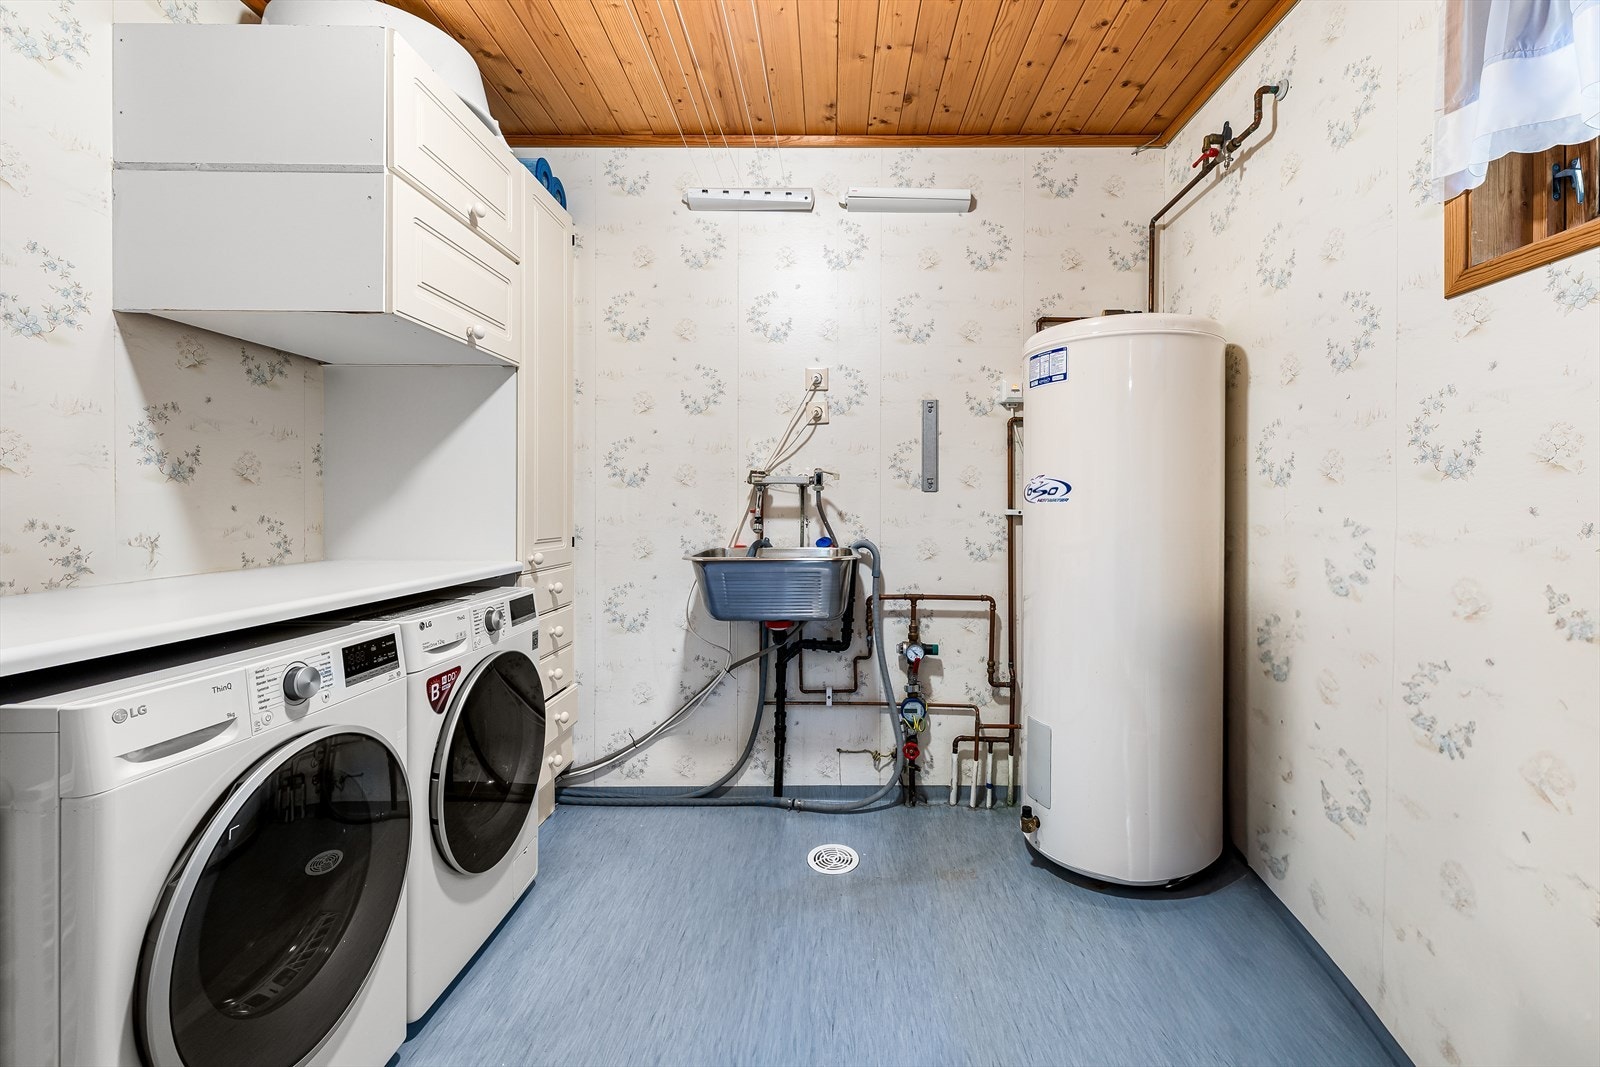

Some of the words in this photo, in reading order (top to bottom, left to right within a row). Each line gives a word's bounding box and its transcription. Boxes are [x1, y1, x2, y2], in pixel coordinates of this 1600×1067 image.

[211, 682, 232, 694] ThinQ
[431, 683, 440, 702] B
[129, 705, 147, 718] LG
